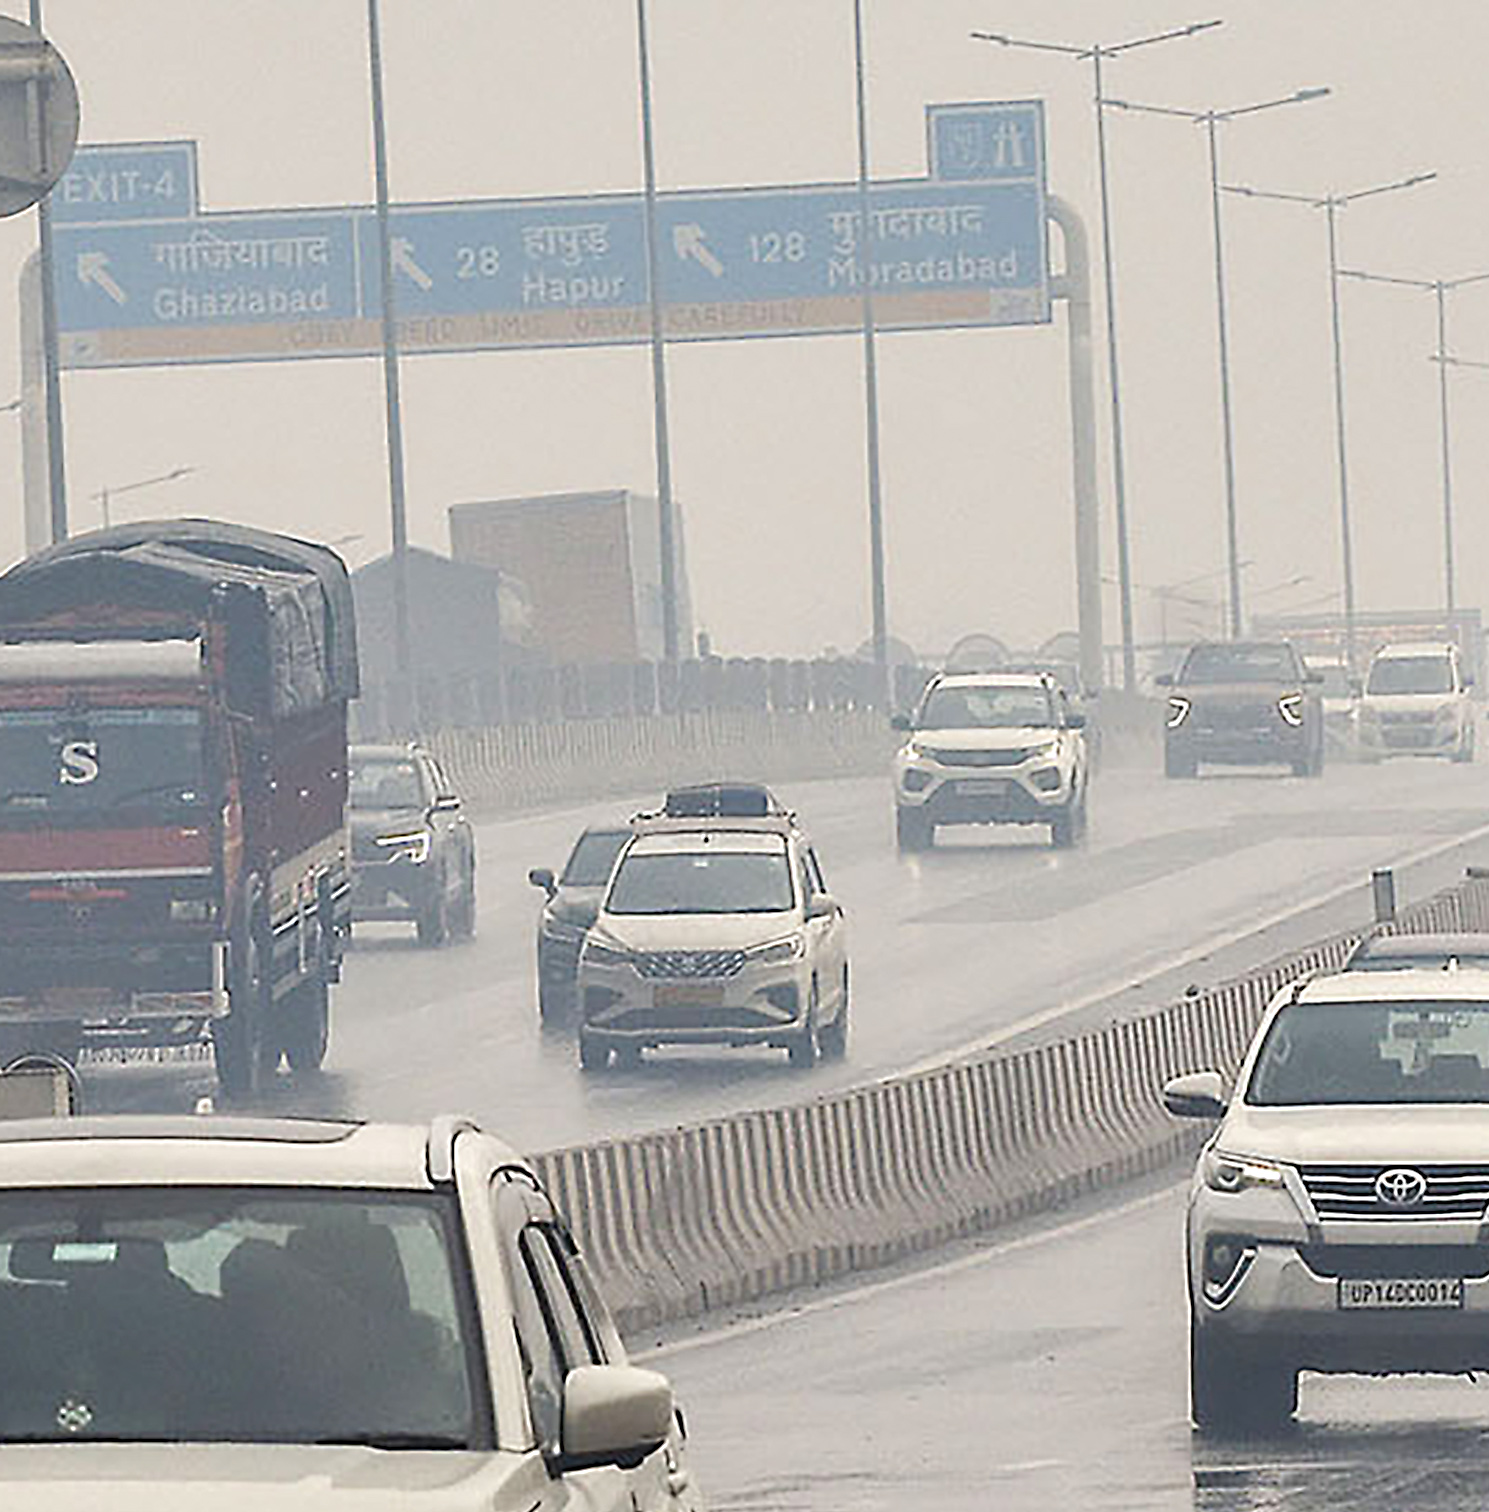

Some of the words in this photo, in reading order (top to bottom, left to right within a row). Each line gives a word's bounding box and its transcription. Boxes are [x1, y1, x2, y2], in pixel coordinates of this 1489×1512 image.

[63, 170, 176, 204] EXIT-4
[456, 245, 500, 280] 28
[748, 232, 807, 263] 128
[827, 247, 1018, 288] Moradabad
[153, 283, 331, 321] Ghaziabad
[521, 270, 625, 305] Hapur
[60, 742, 98, 784] S
